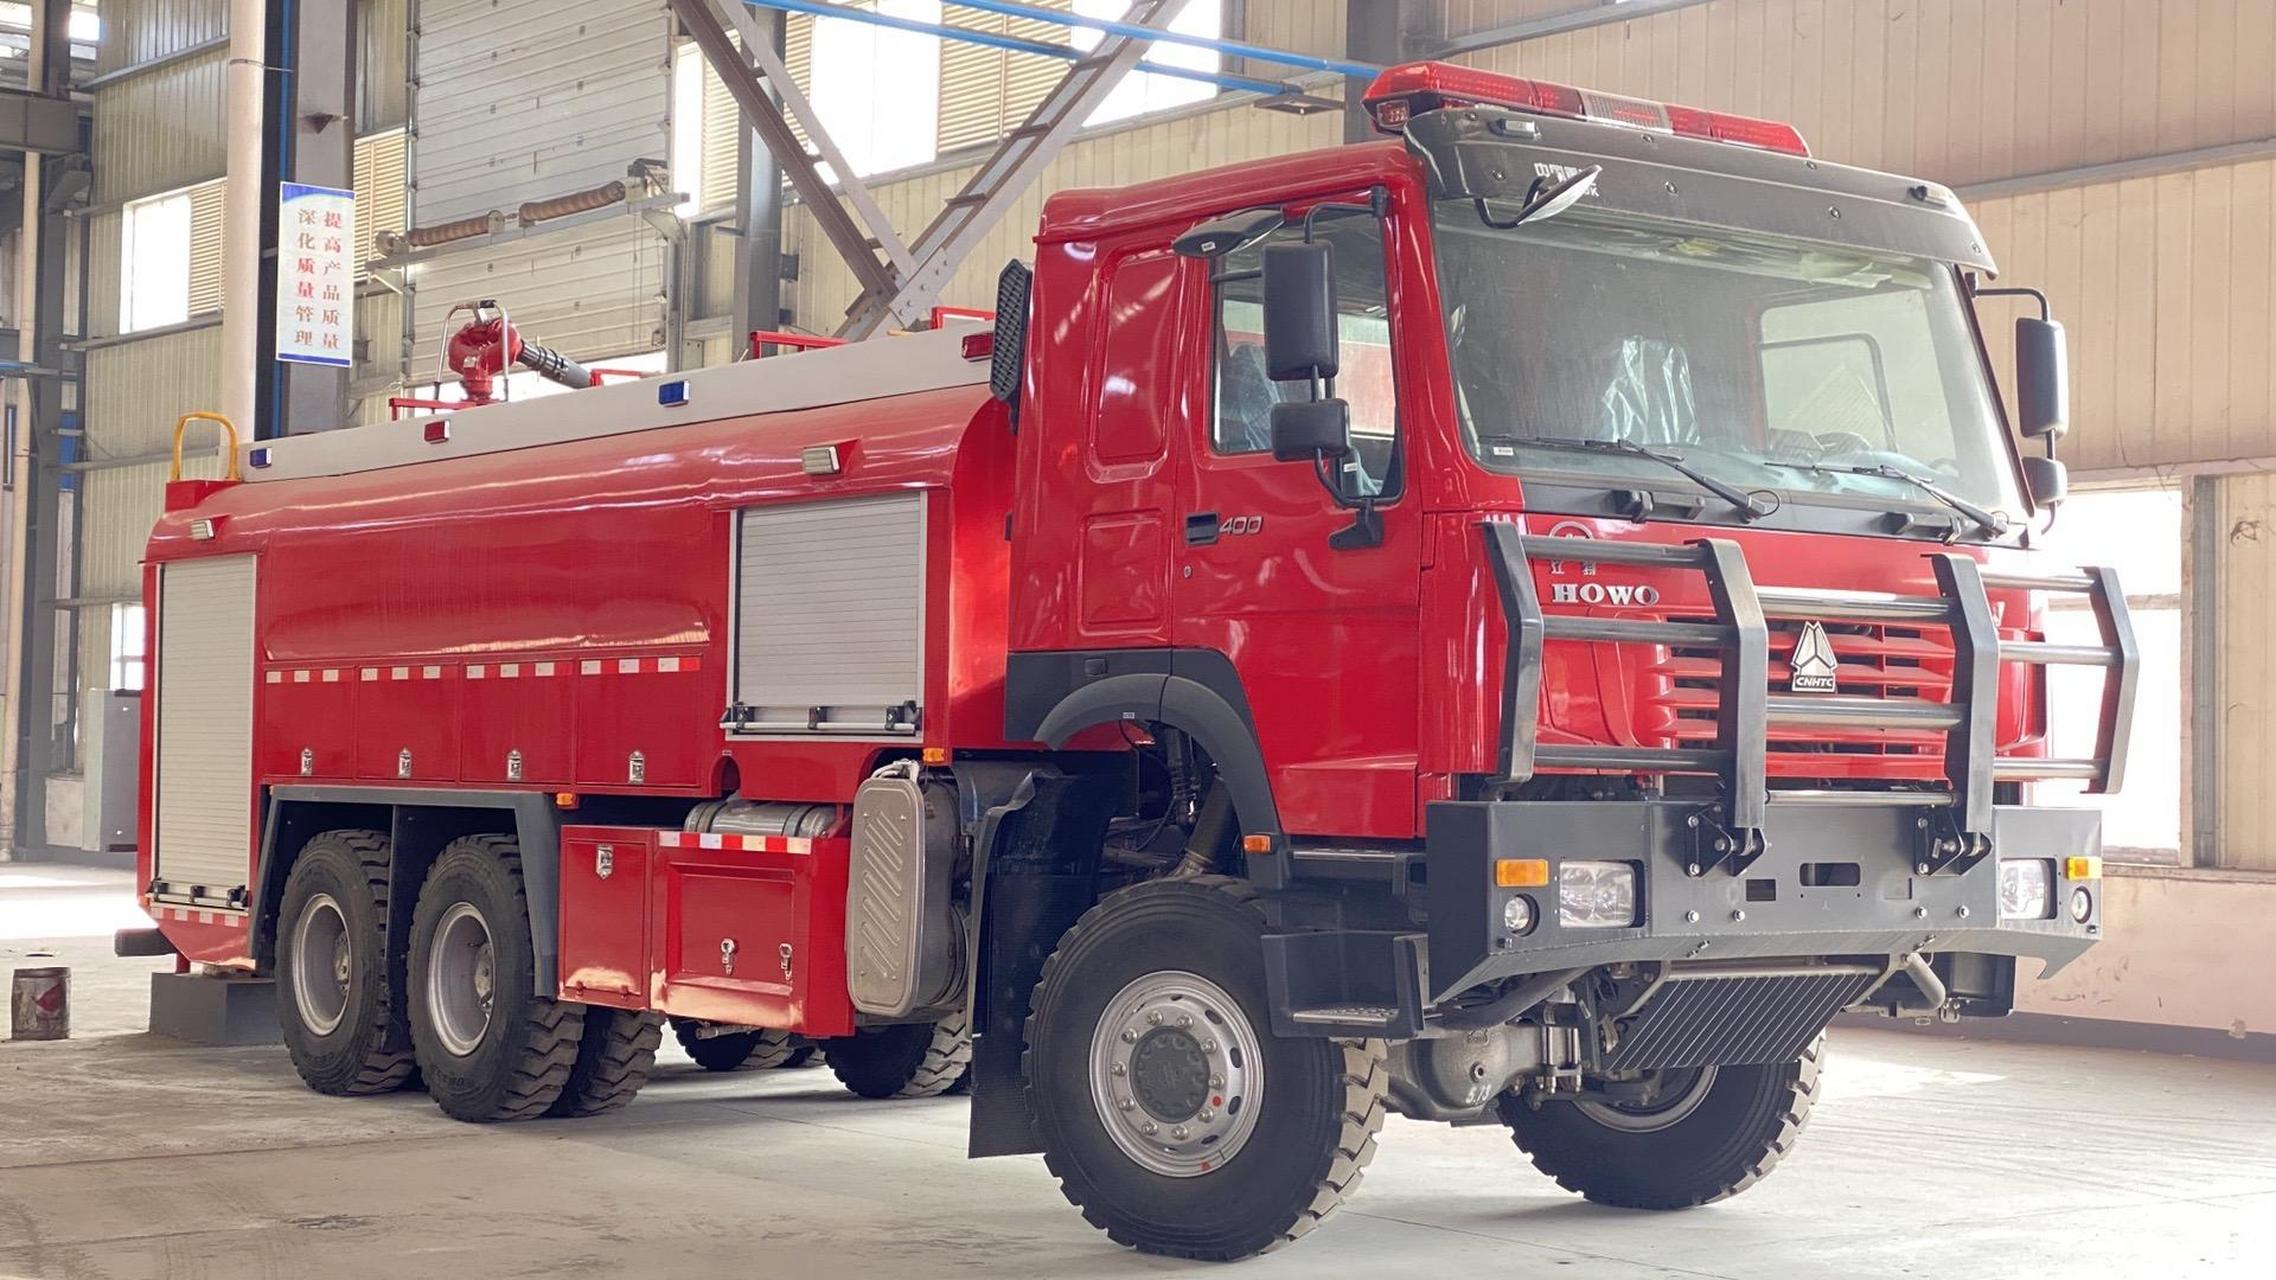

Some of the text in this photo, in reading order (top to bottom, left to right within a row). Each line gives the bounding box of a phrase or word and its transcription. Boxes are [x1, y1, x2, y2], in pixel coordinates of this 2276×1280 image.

[294, 208, 317, 346] 深化质量管理
[322, 210, 342, 350] 提高产品质量
[1219, 516, 1263, 535] 400
[1551, 583, 1659, 606] HOWO
[1796, 676, 1833, 687] CNHTC
